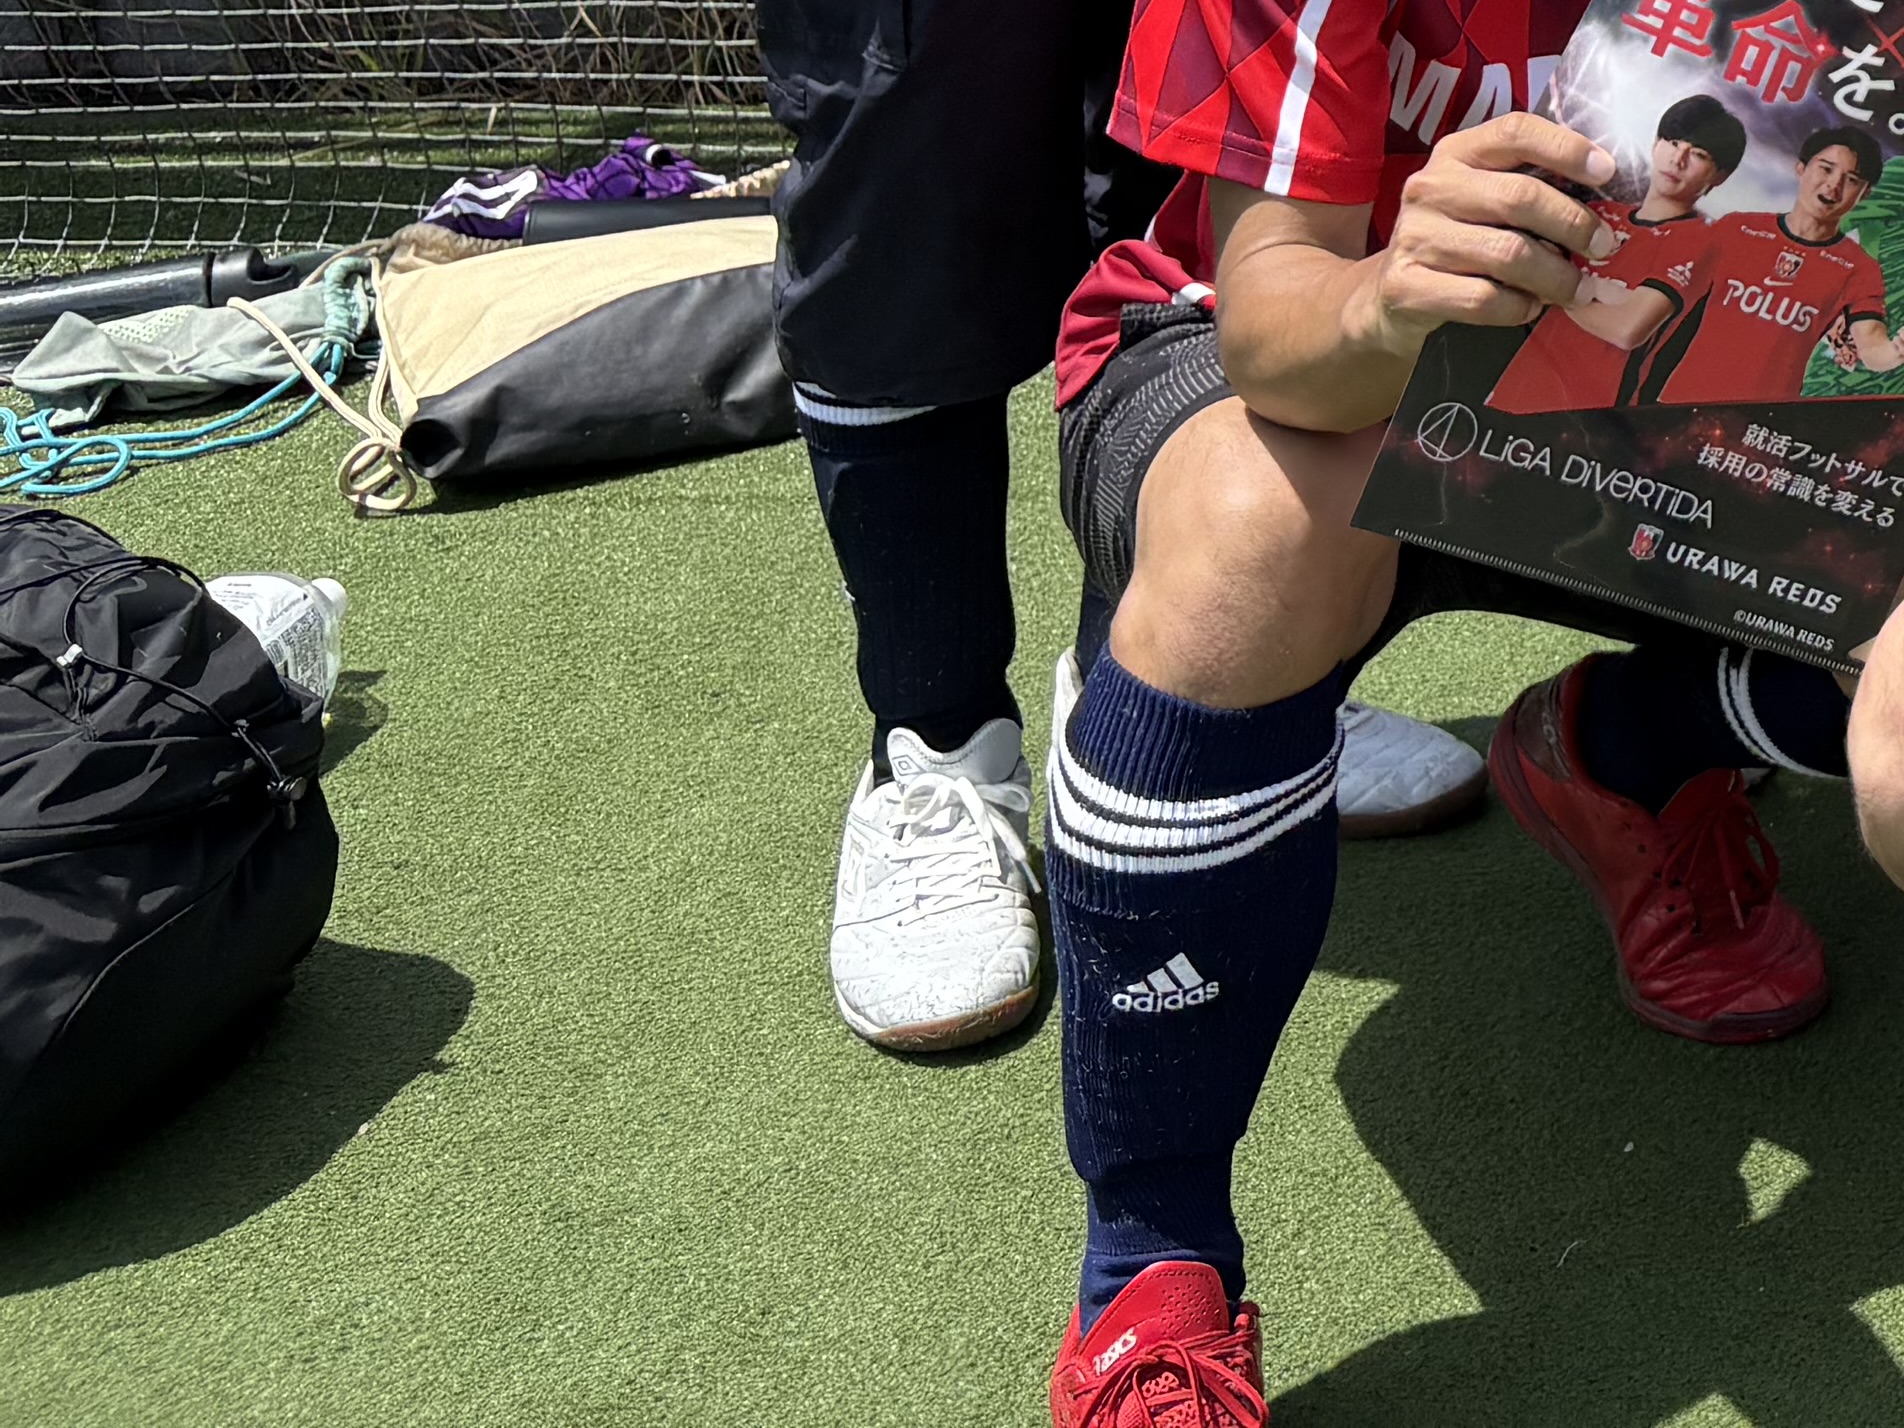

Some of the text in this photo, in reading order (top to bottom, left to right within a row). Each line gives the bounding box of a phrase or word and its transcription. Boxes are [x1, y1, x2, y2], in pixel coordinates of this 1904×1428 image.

[1723, 278, 1820, 334] POLUS
[1697, 442, 1898, 530] 採用の常識を変える
[1666, 541, 1841, 615] URAWA REDS
[1734, 608, 1835, 652] ©URAWA REDS
[1112, 981, 1219, 1012] adidas
